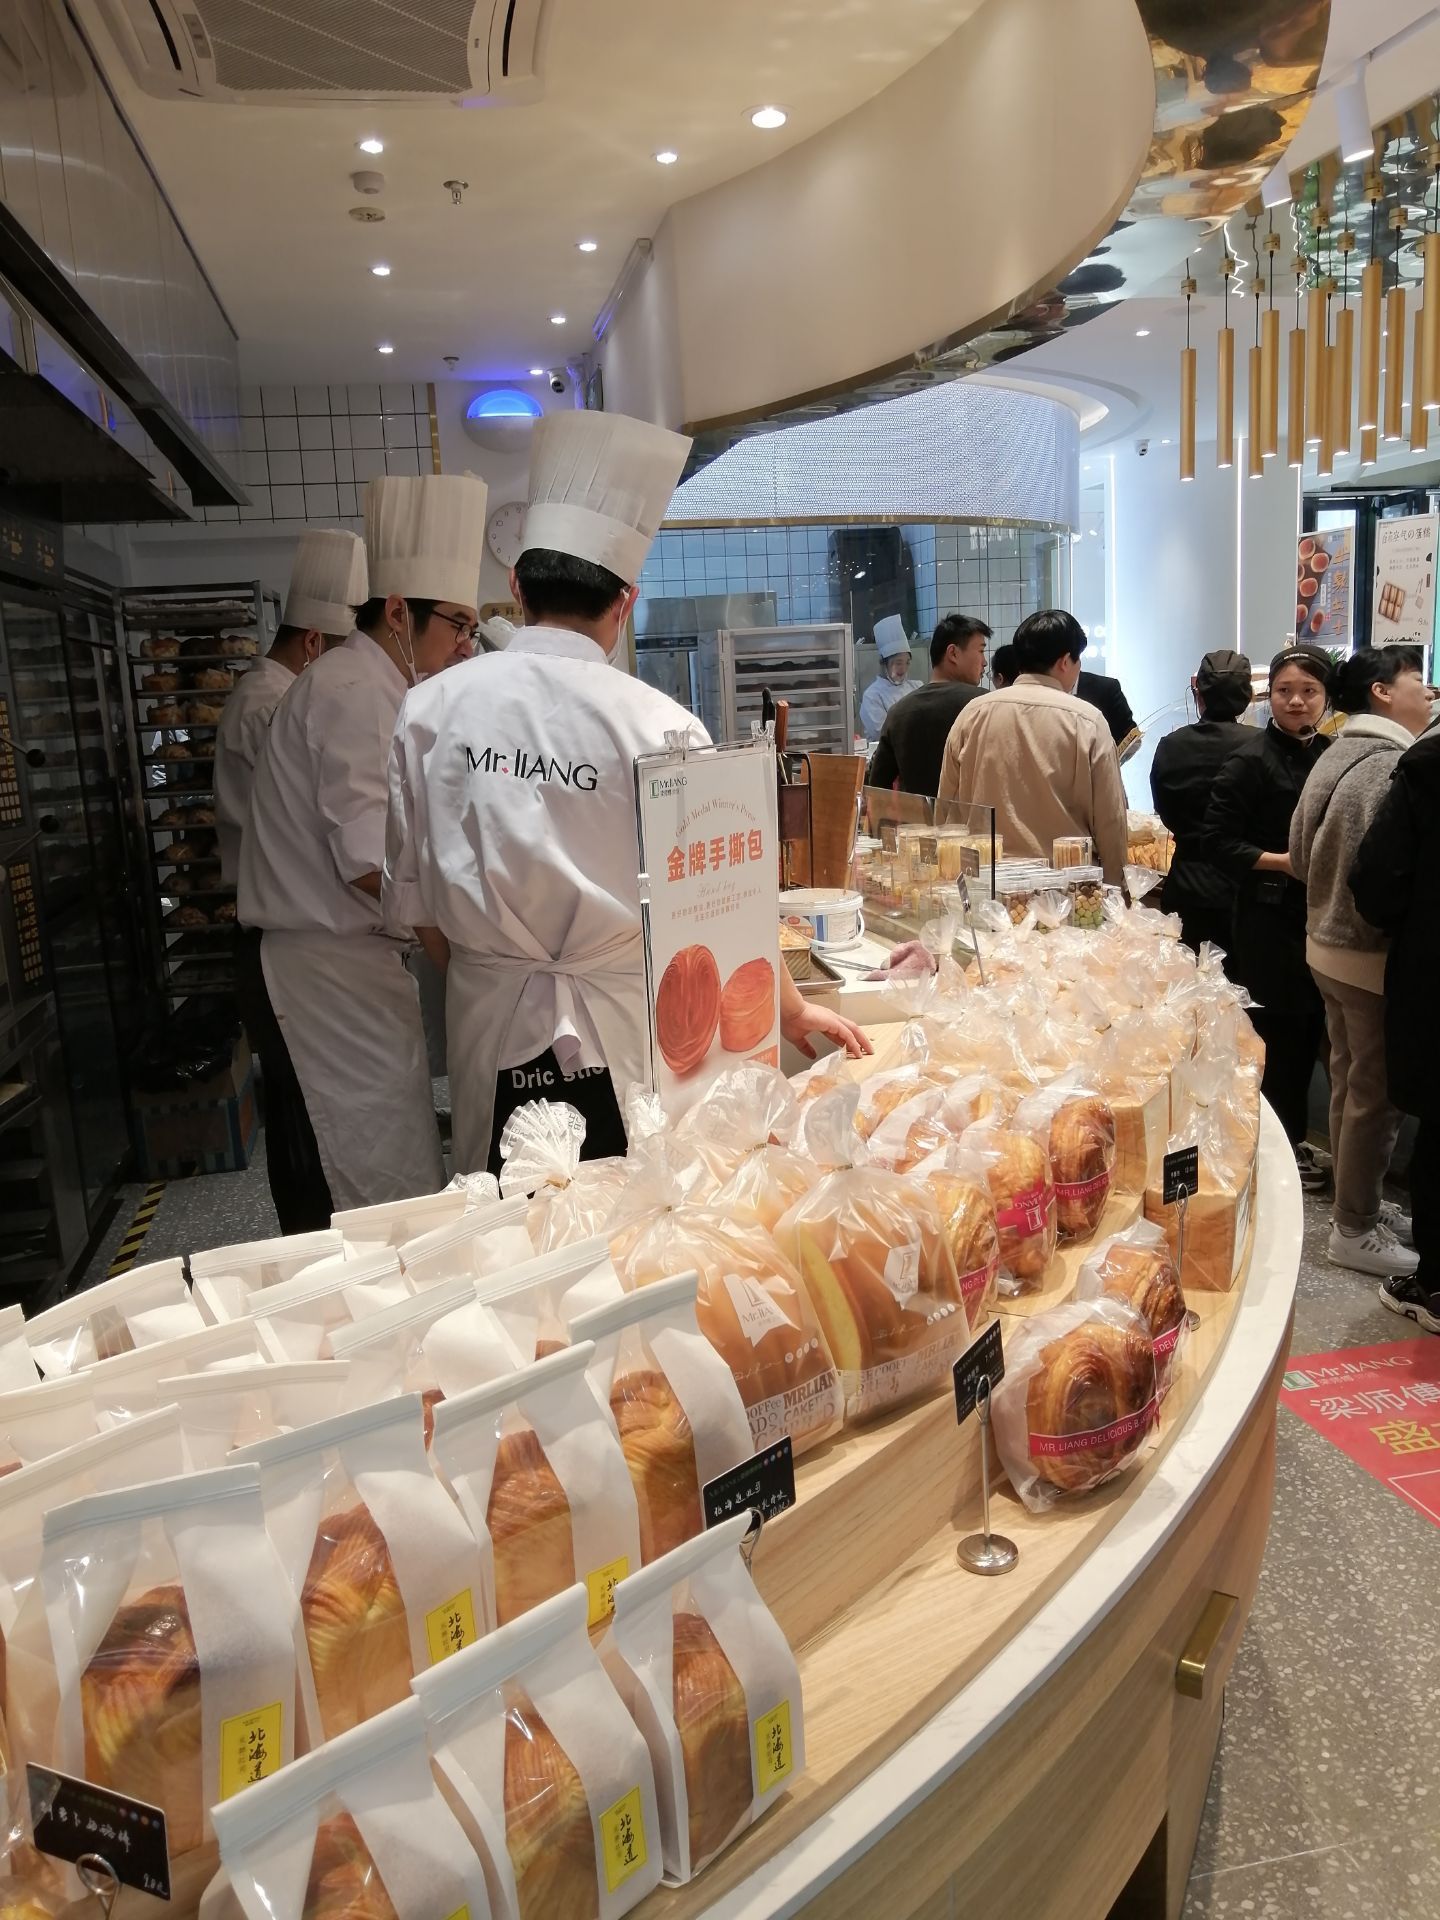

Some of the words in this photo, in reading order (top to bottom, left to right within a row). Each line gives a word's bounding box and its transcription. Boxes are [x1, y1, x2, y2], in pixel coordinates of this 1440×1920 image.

[666, 829, 764, 883] 金牌手撕包
[511, 1067, 555, 1089] Dric
[1058, 1438, 1088, 1451] LIANG
[1090, 1422, 1133, 1446] DELICIOUS
[1368, 1419, 1440, 1456] 盛
[247, 1727, 269, 1784] 北海道
[771, 1723, 786, 1773] 北海道
[620, 1813, 639, 1866] 北海道
